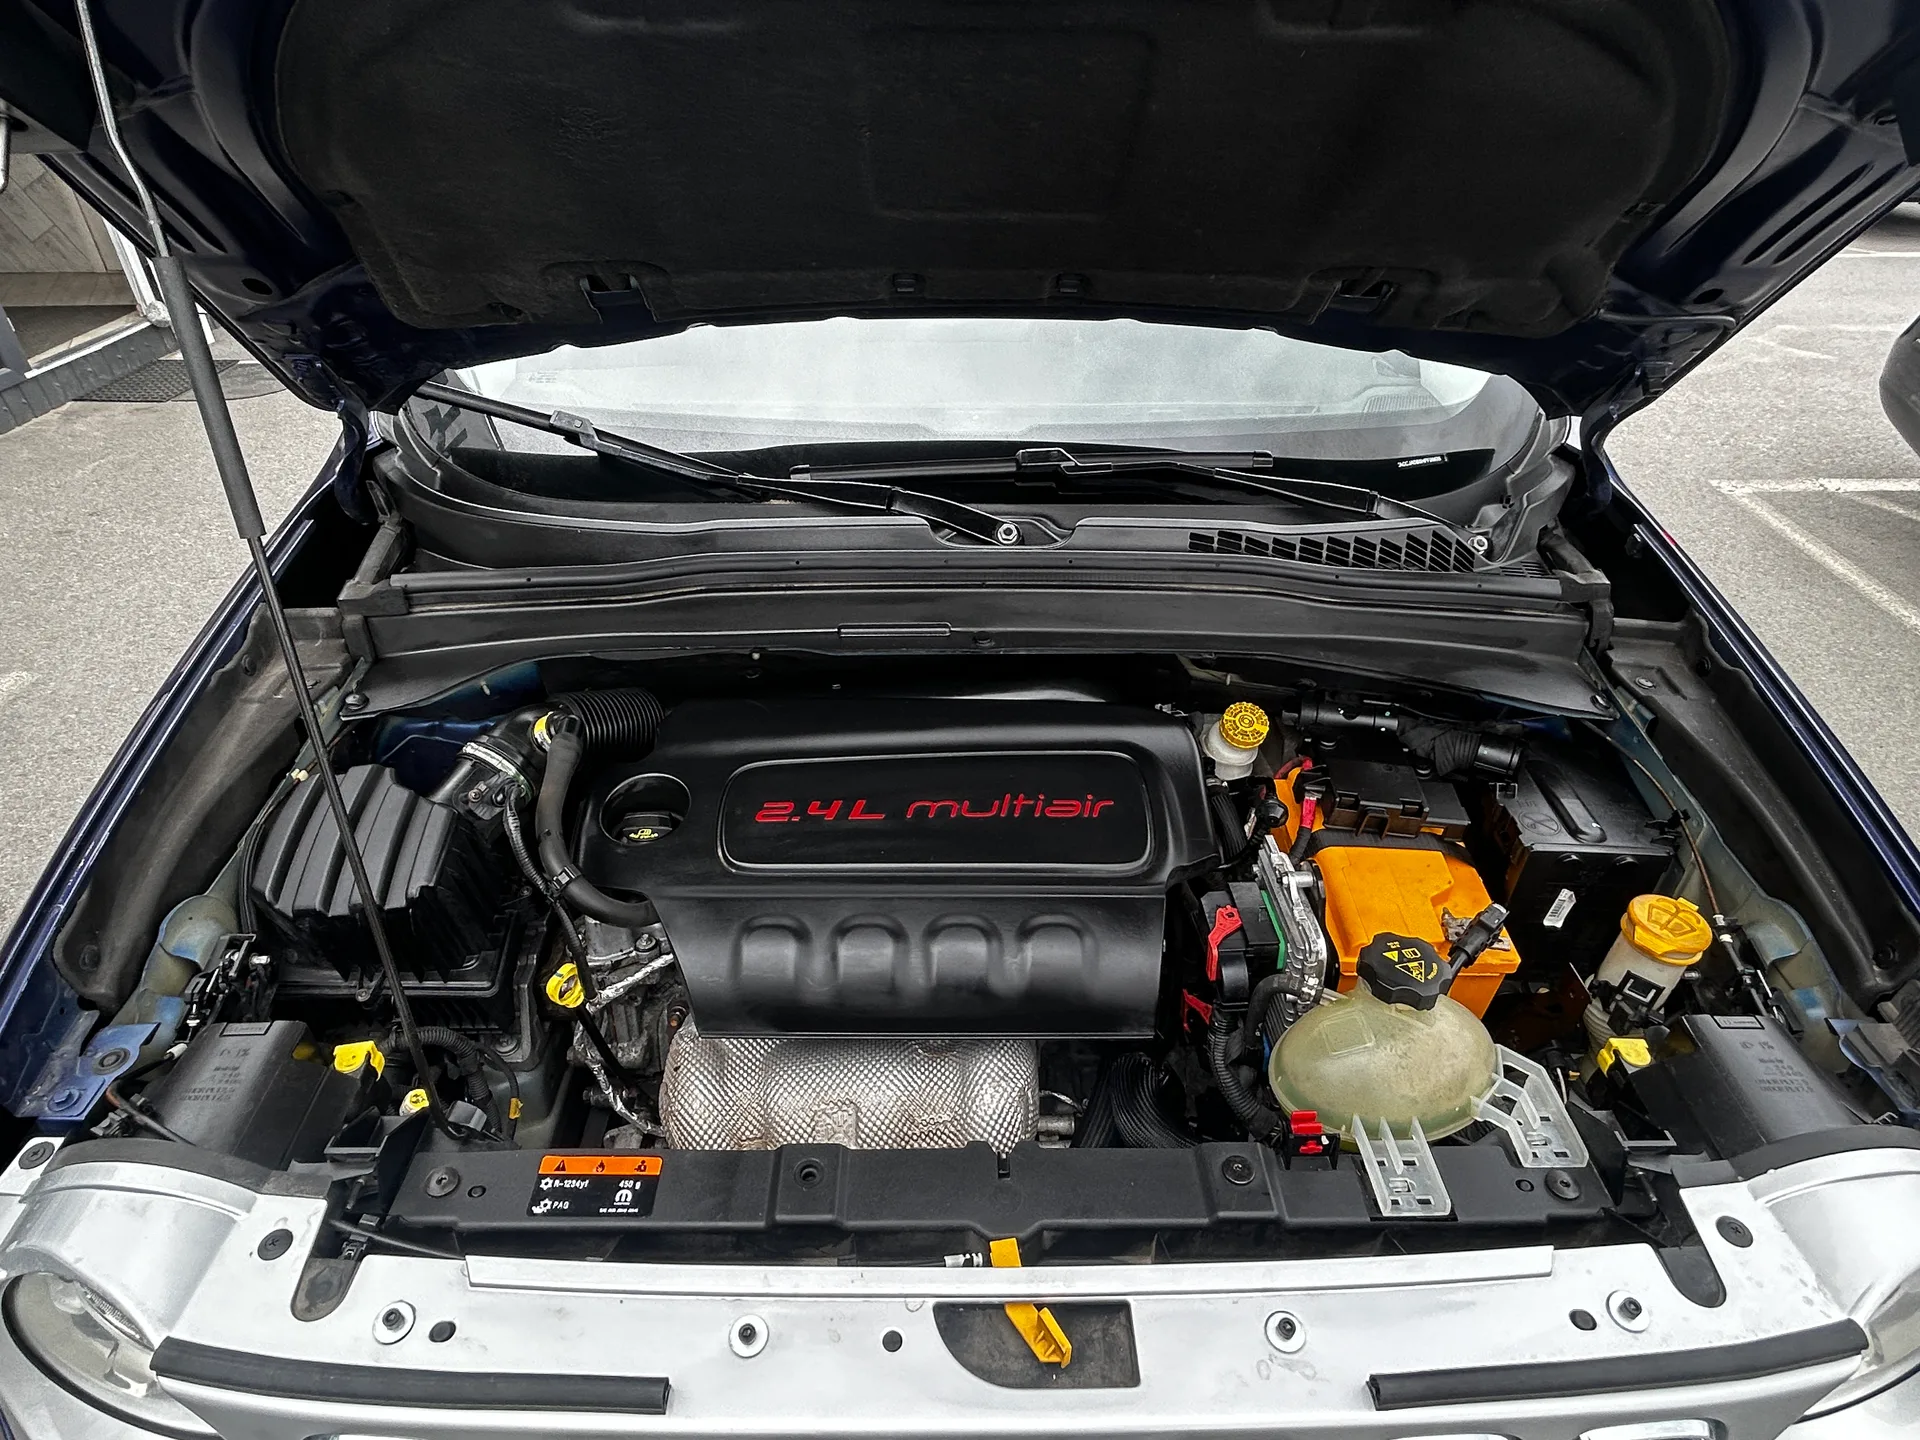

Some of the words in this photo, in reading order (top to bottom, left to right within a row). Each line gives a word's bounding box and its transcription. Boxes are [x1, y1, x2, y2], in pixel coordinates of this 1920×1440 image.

[754, 799, 886, 823] 2.4L
[906, 792, 1115, 819] multiair
[553, 1178, 590, 1190] R-1234yf
[618, 1179, 634, 1190] 450
